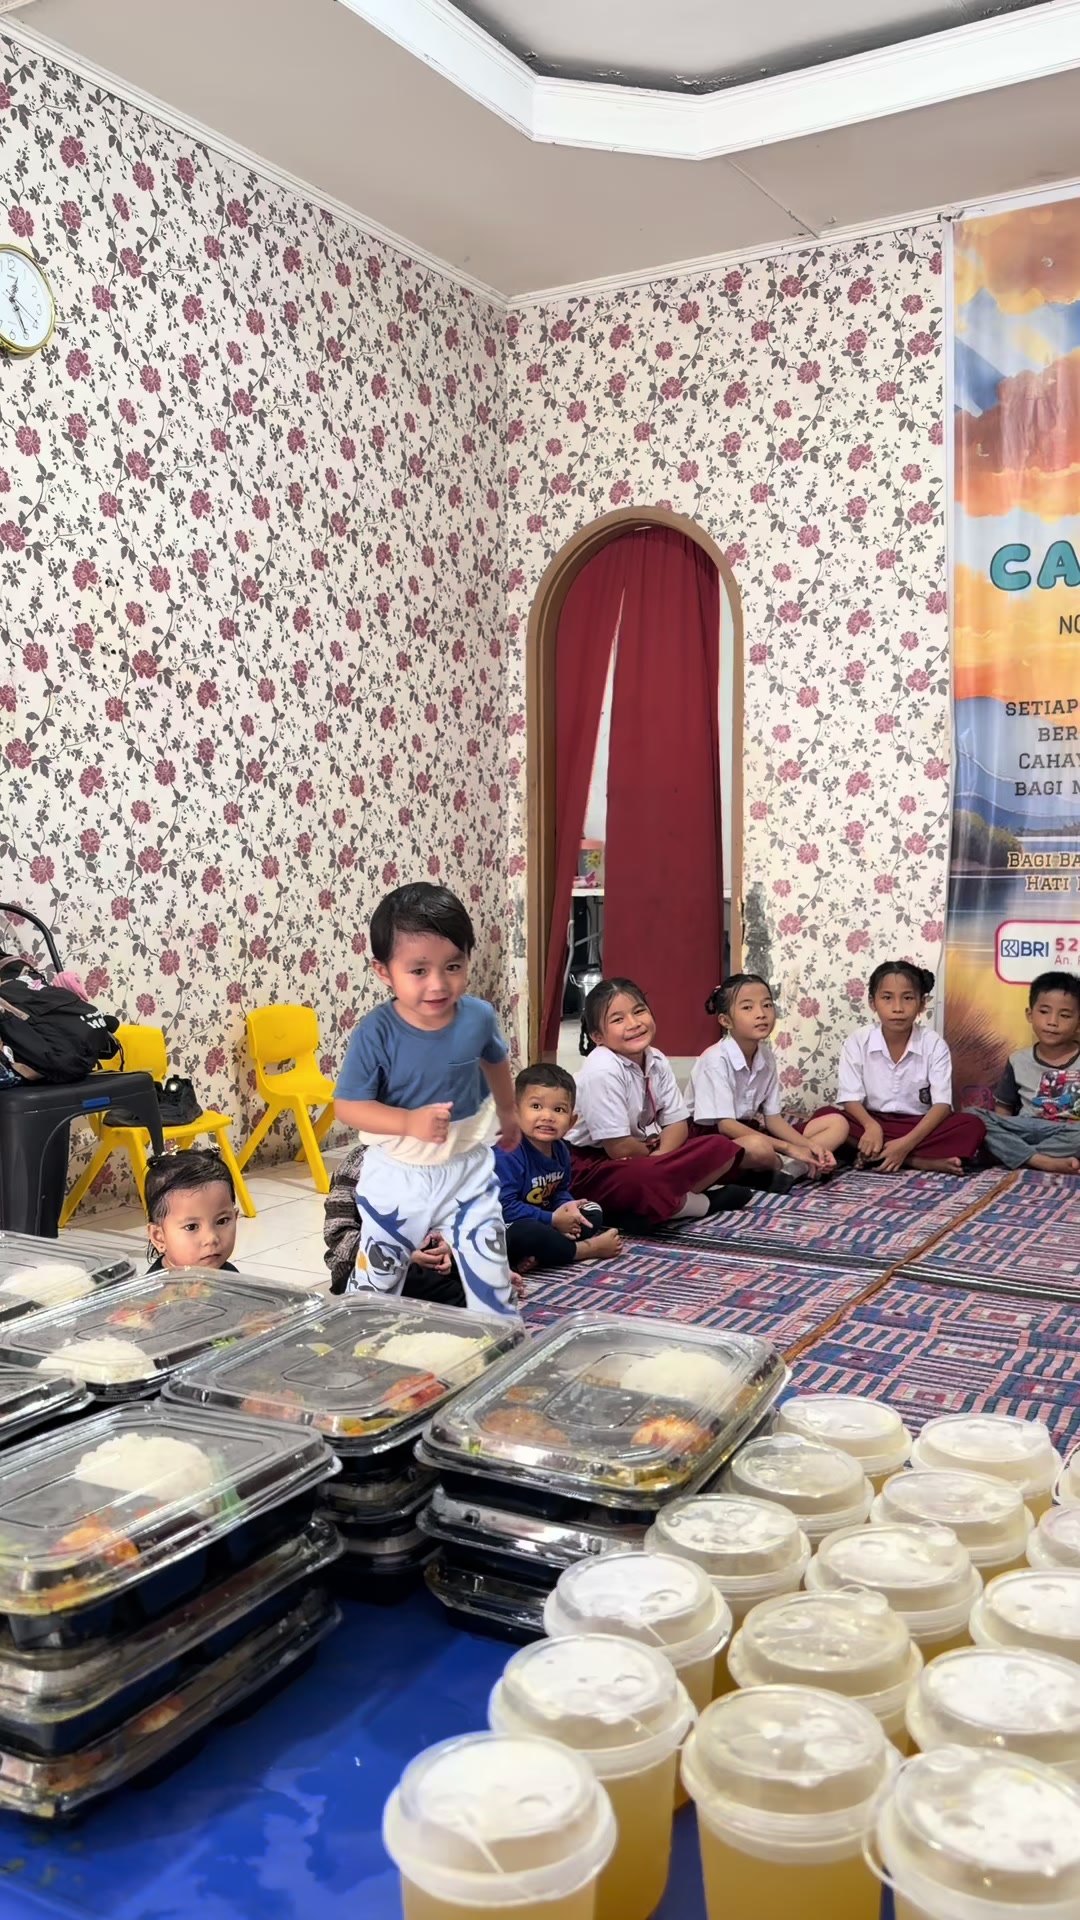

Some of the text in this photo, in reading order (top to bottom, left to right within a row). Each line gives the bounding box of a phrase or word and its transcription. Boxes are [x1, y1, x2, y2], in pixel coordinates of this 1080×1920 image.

[990, 540, 1080, 591] CA
[1005, 699, 1079, 716] SETIAP
[1037, 725, 1079, 742] BER
[1014, 780, 1063, 796] BAGI
[1008, 852, 1051, 868] BAGI
[1026, 875, 1069, 891] HATI
[1020, 941, 1049, 957] BRI
